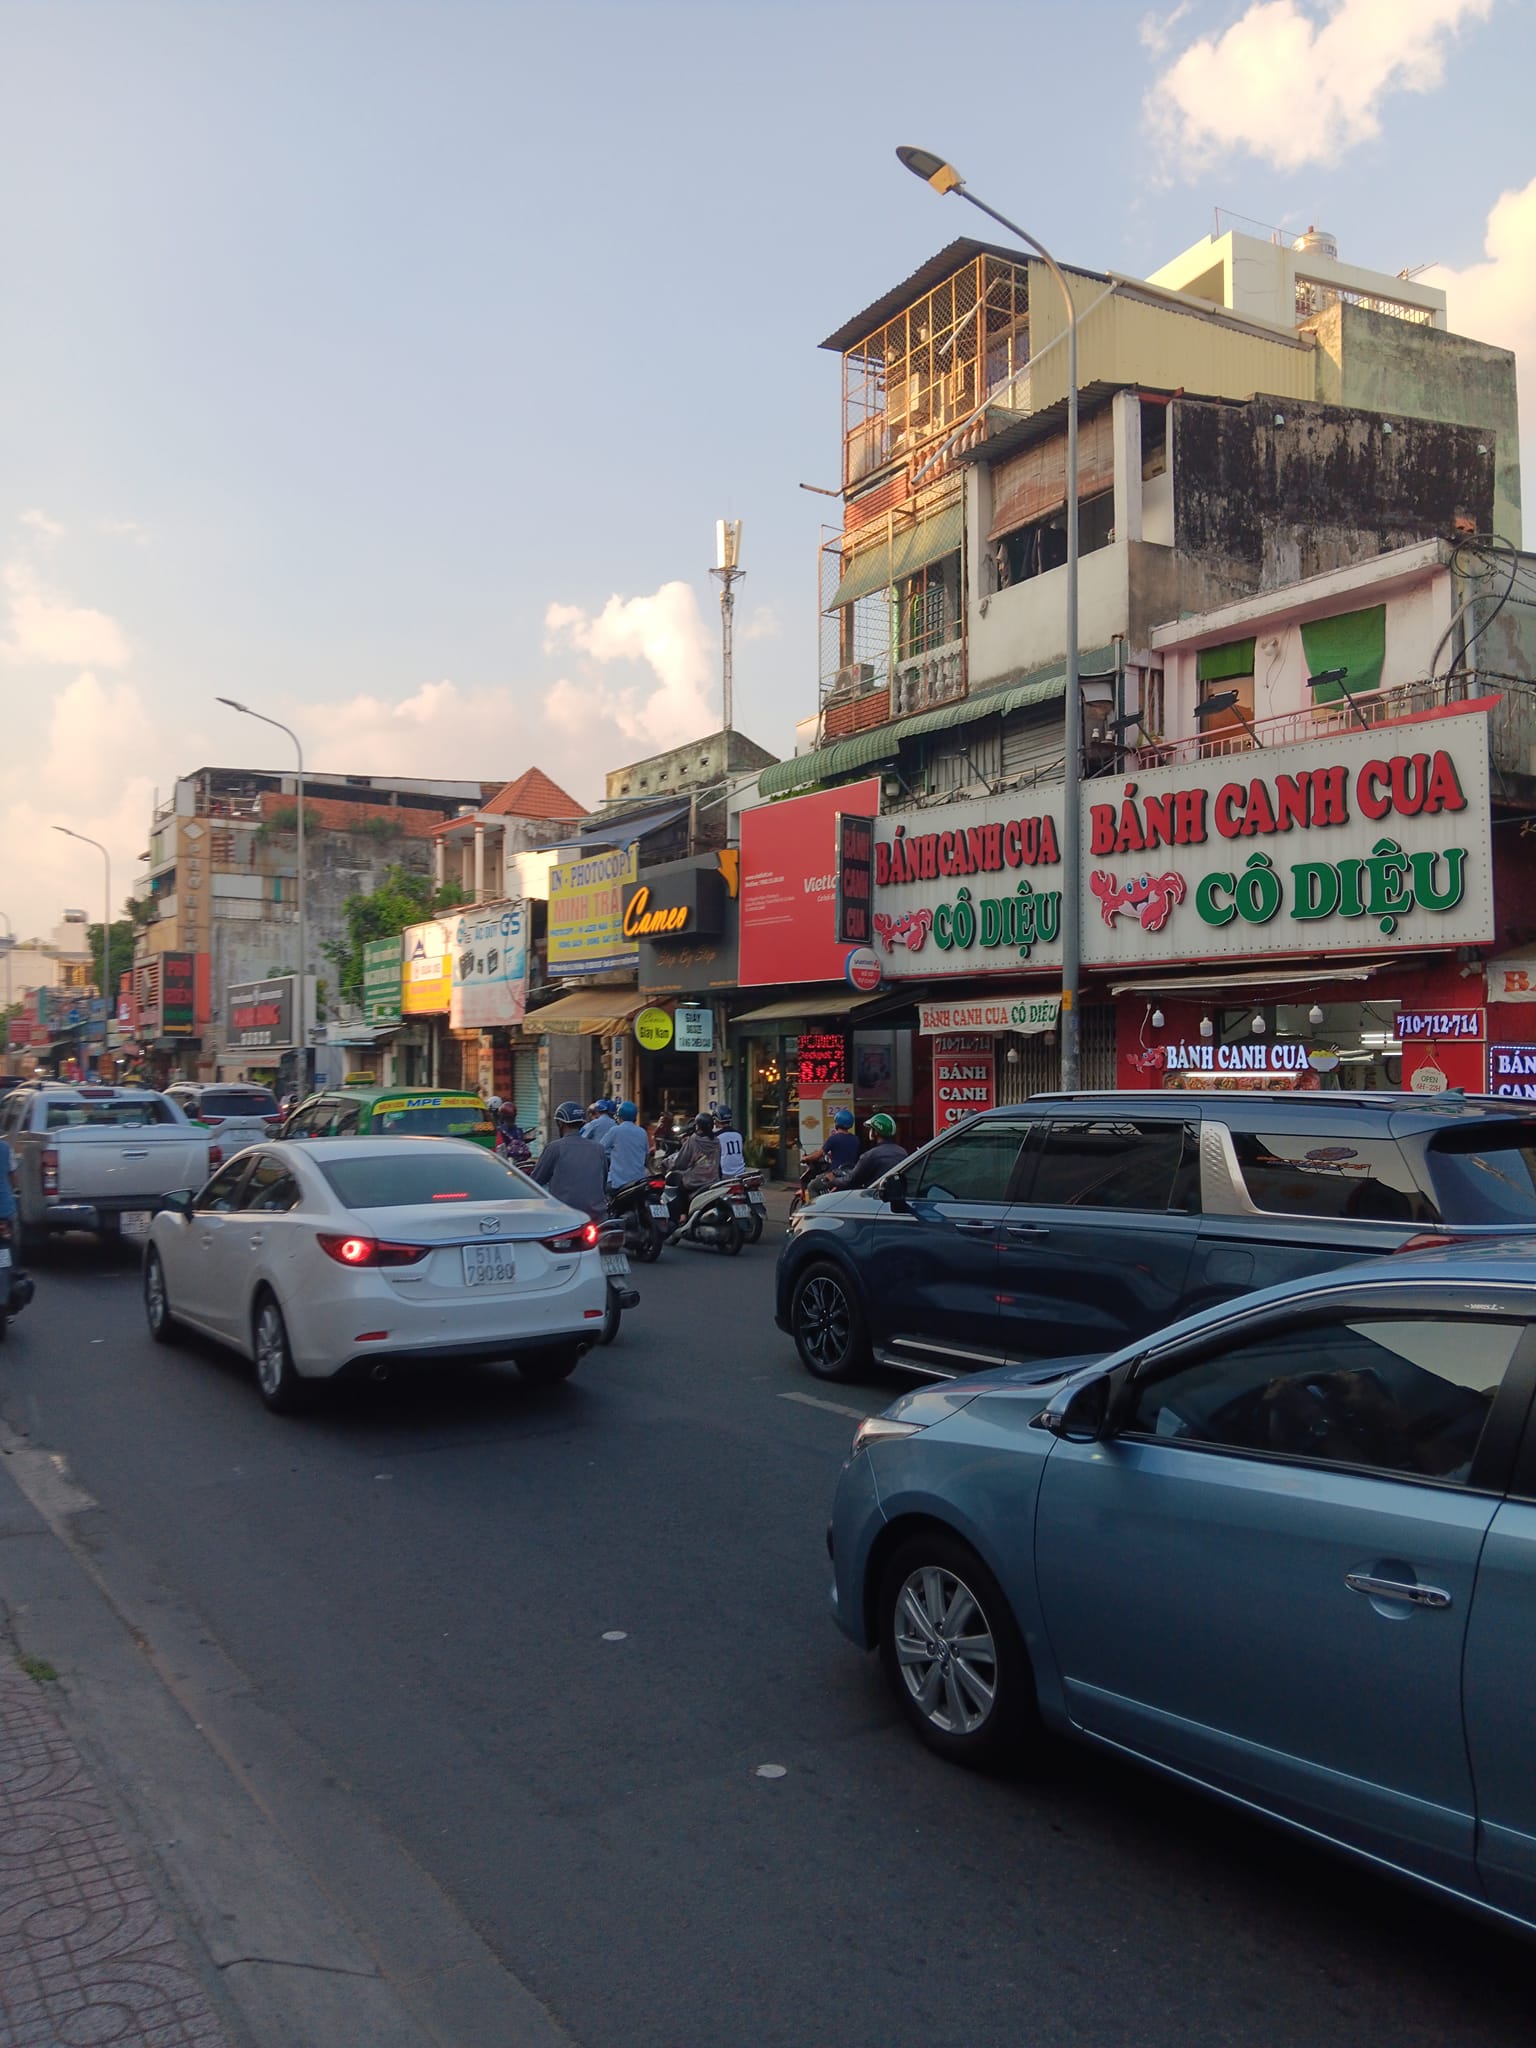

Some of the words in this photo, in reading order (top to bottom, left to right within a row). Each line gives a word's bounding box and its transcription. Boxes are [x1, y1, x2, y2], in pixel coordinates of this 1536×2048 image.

[1090, 782, 1208, 855] BÁNH
[1215, 766, 1349, 839] CANH
[1357, 750, 1468, 820] CUA
[876, 825, 939, 885] BÁNH
[938, 823, 1004, 876] CANH
[1004, 815, 1060, 867] CUA
[552, 869, 563, 892] IN
[571, 850, 633, 888] PHOTOCOPY
[1195, 852, 1283, 927] CÔ
[1290, 837, 1469, 935] DIỆU
[623, 886, 688, 936] Cameo
[933, 887, 976, 950] CÔ
[979, 879, 1062, 959] DIỆU
[500, 912, 521, 936] GS
[1504, 970, 1536, 993] B
[923, 1007, 950, 1028] BÁNH
[953, 1007, 982, 1026] CANH
[985, 1007, 1009, 1025] CUA
[1011, 1002, 1026, 1024] CÔ
[1029, 1000, 1057, 1027] DIỆU
[1397, 1013, 1478, 1037] 710-712-714
[1166, 1038, 1214, 1070] BÁNH
[1218, 1045, 1267, 1070] CANH
[1271, 1044, 1309, 1070] CUA
[939, 1062, 987, 1080] BÁNH
[1421, 1075, 1438, 1084] OPEN
[406, 1098, 442, 1107] MPE
[939, 1087, 987, 1100] CANH
[945, 1108, 977, 1122] CU
[726, 1140, 741, 1156] 01
